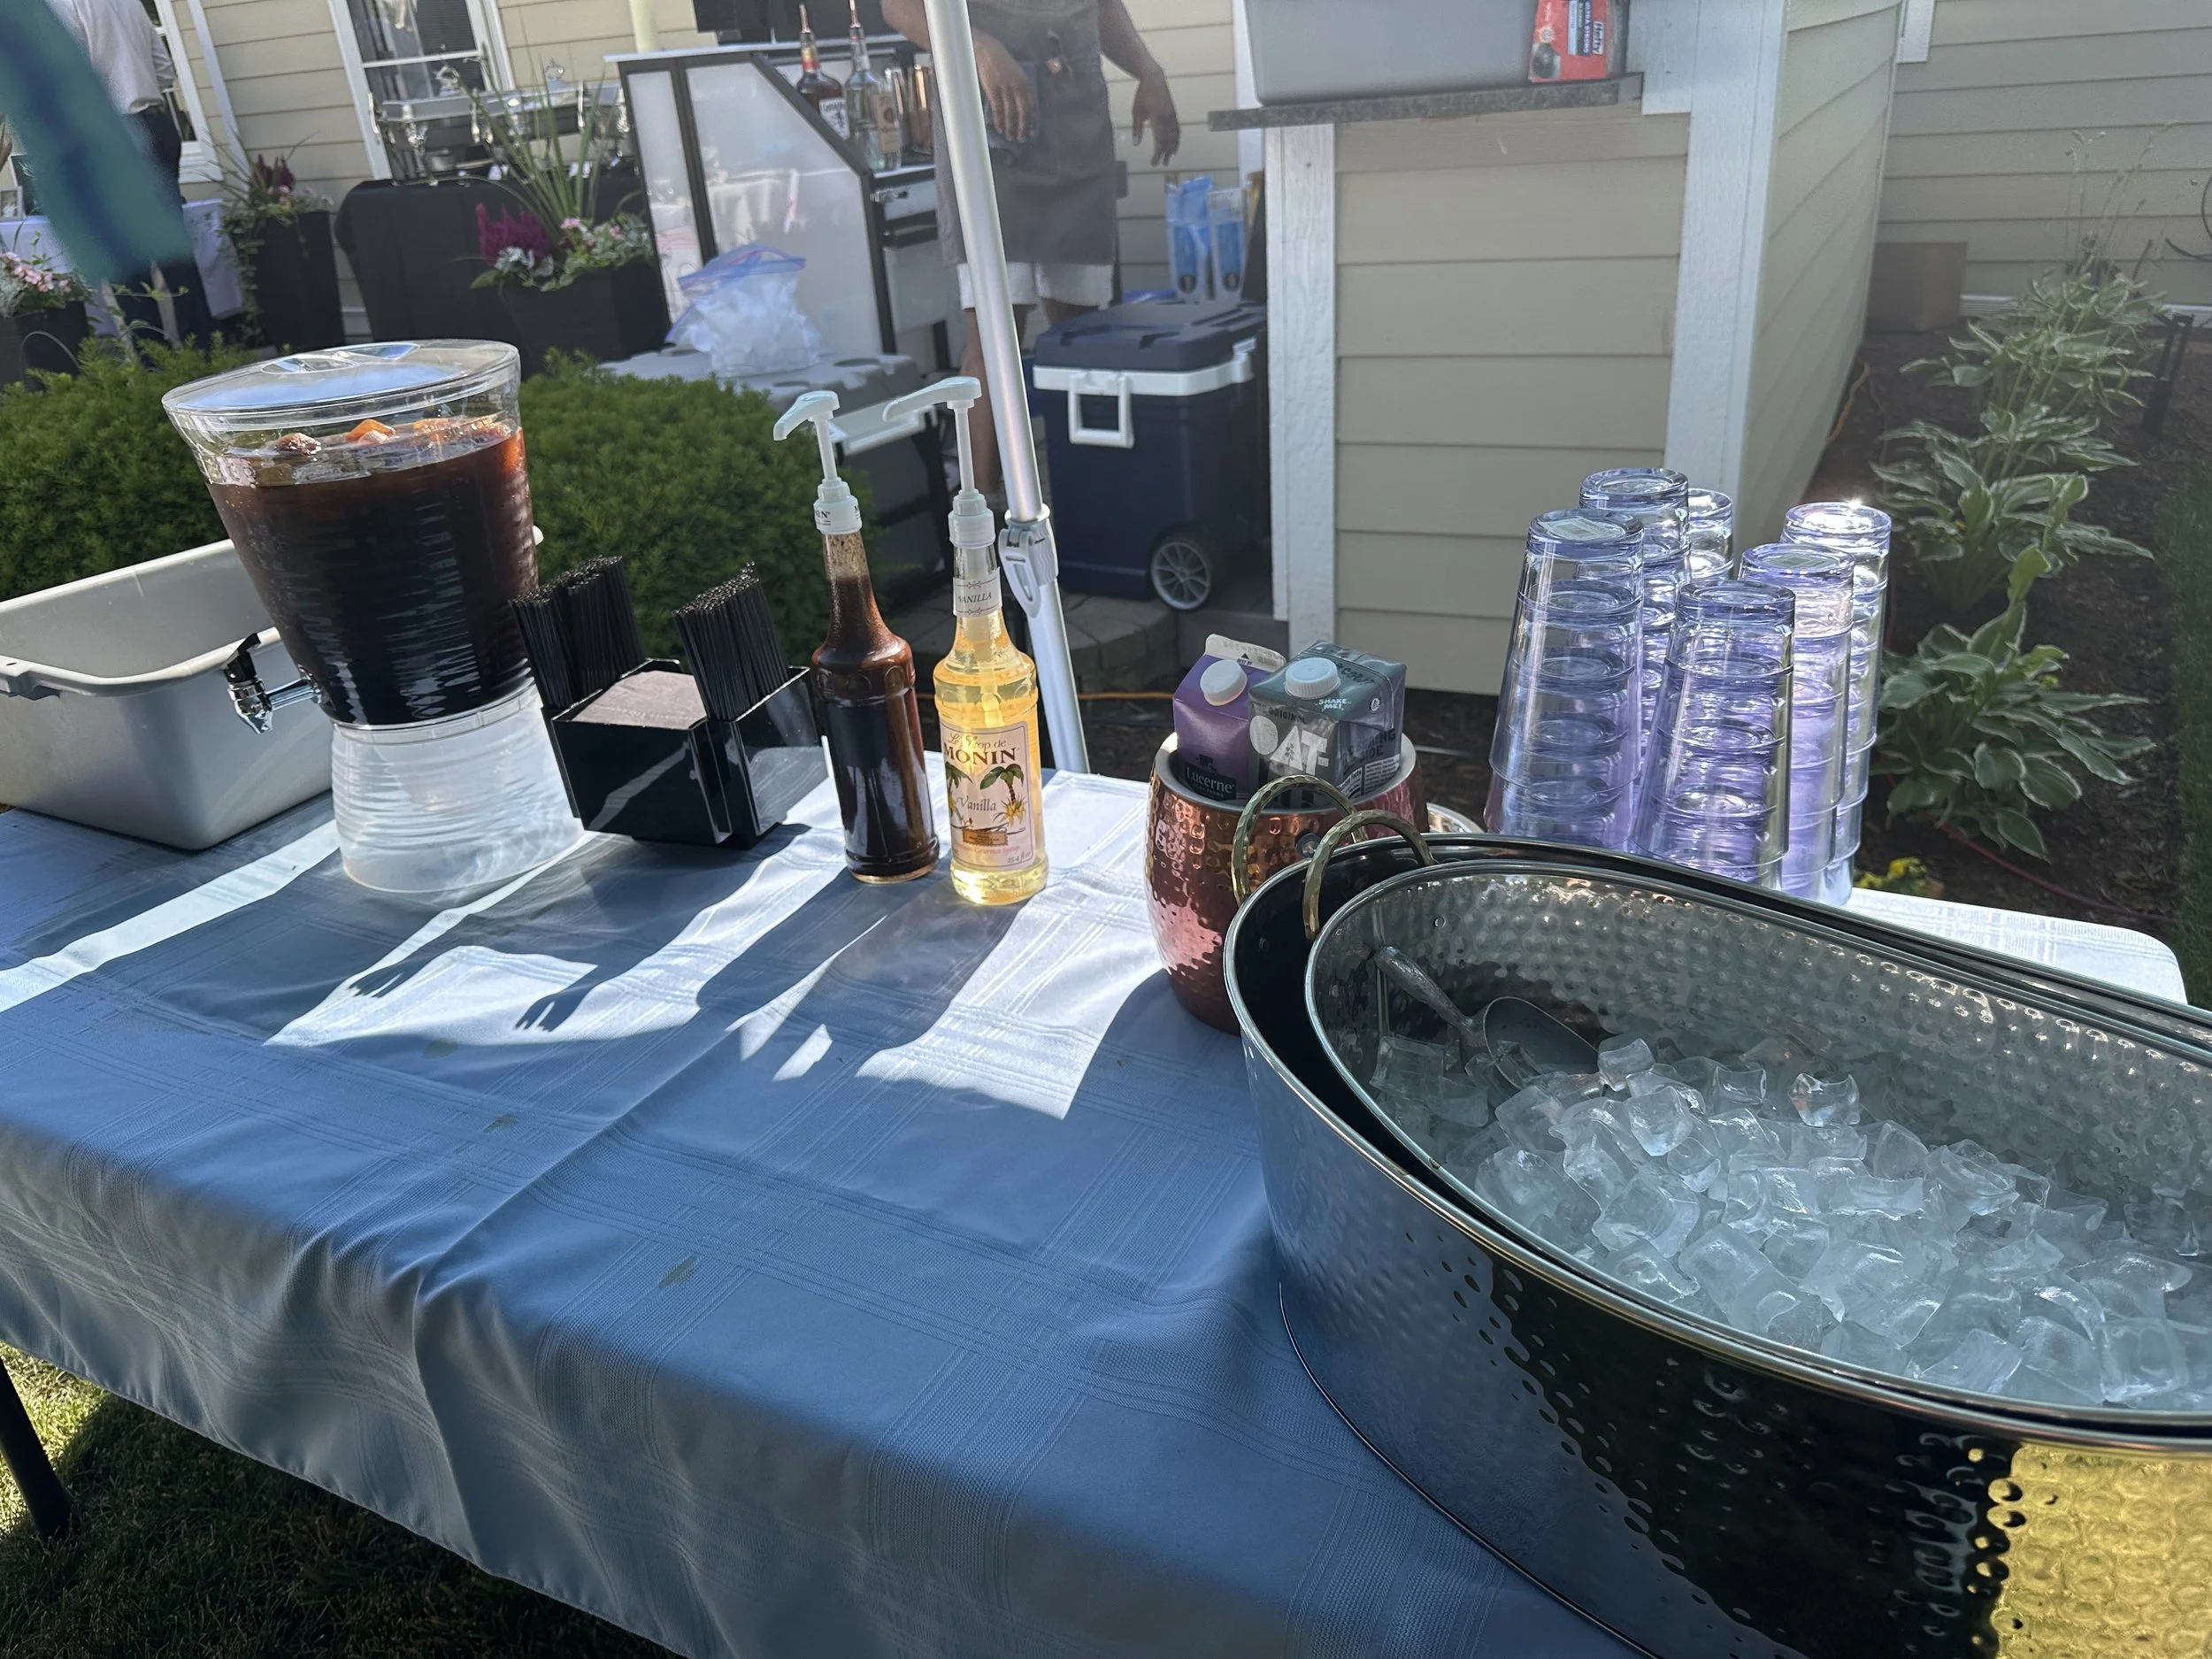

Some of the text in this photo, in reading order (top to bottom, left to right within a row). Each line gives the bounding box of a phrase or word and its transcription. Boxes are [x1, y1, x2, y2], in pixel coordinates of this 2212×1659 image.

[957, 591, 993, 604] VANILLA
[994, 739, 1007, 748] de
[943, 742, 1017, 766] MONIN
[1187, 766, 1233, 794] Lucerne
[956, 795, 997, 812] Vanilla
